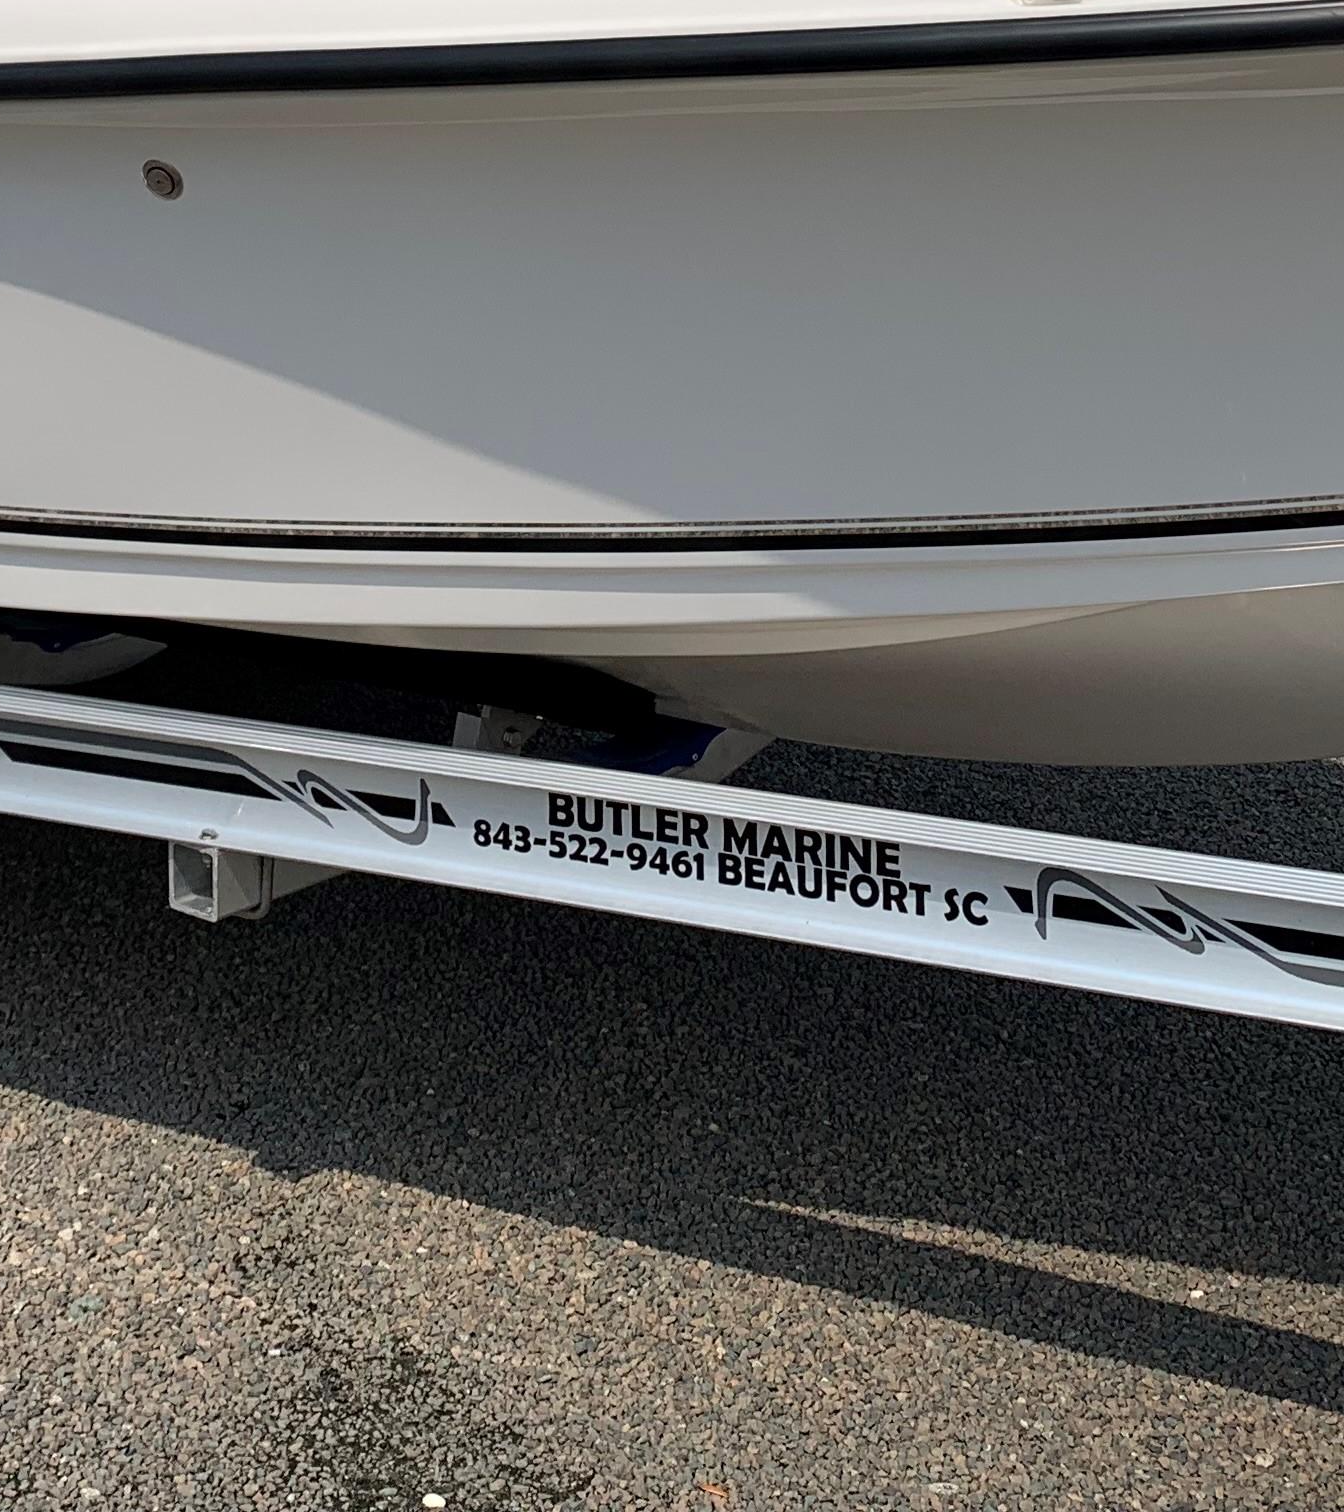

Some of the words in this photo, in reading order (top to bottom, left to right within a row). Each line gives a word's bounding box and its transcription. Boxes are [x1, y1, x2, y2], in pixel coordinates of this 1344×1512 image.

[473, 819, 705, 881] 843-522-9461
[718, 852, 932, 916] BEAUFORT
[944, 888, 989, 926] SC
[548, 792, 709, 850] BUTLER
[722, 818, 901, 879] MARINE
